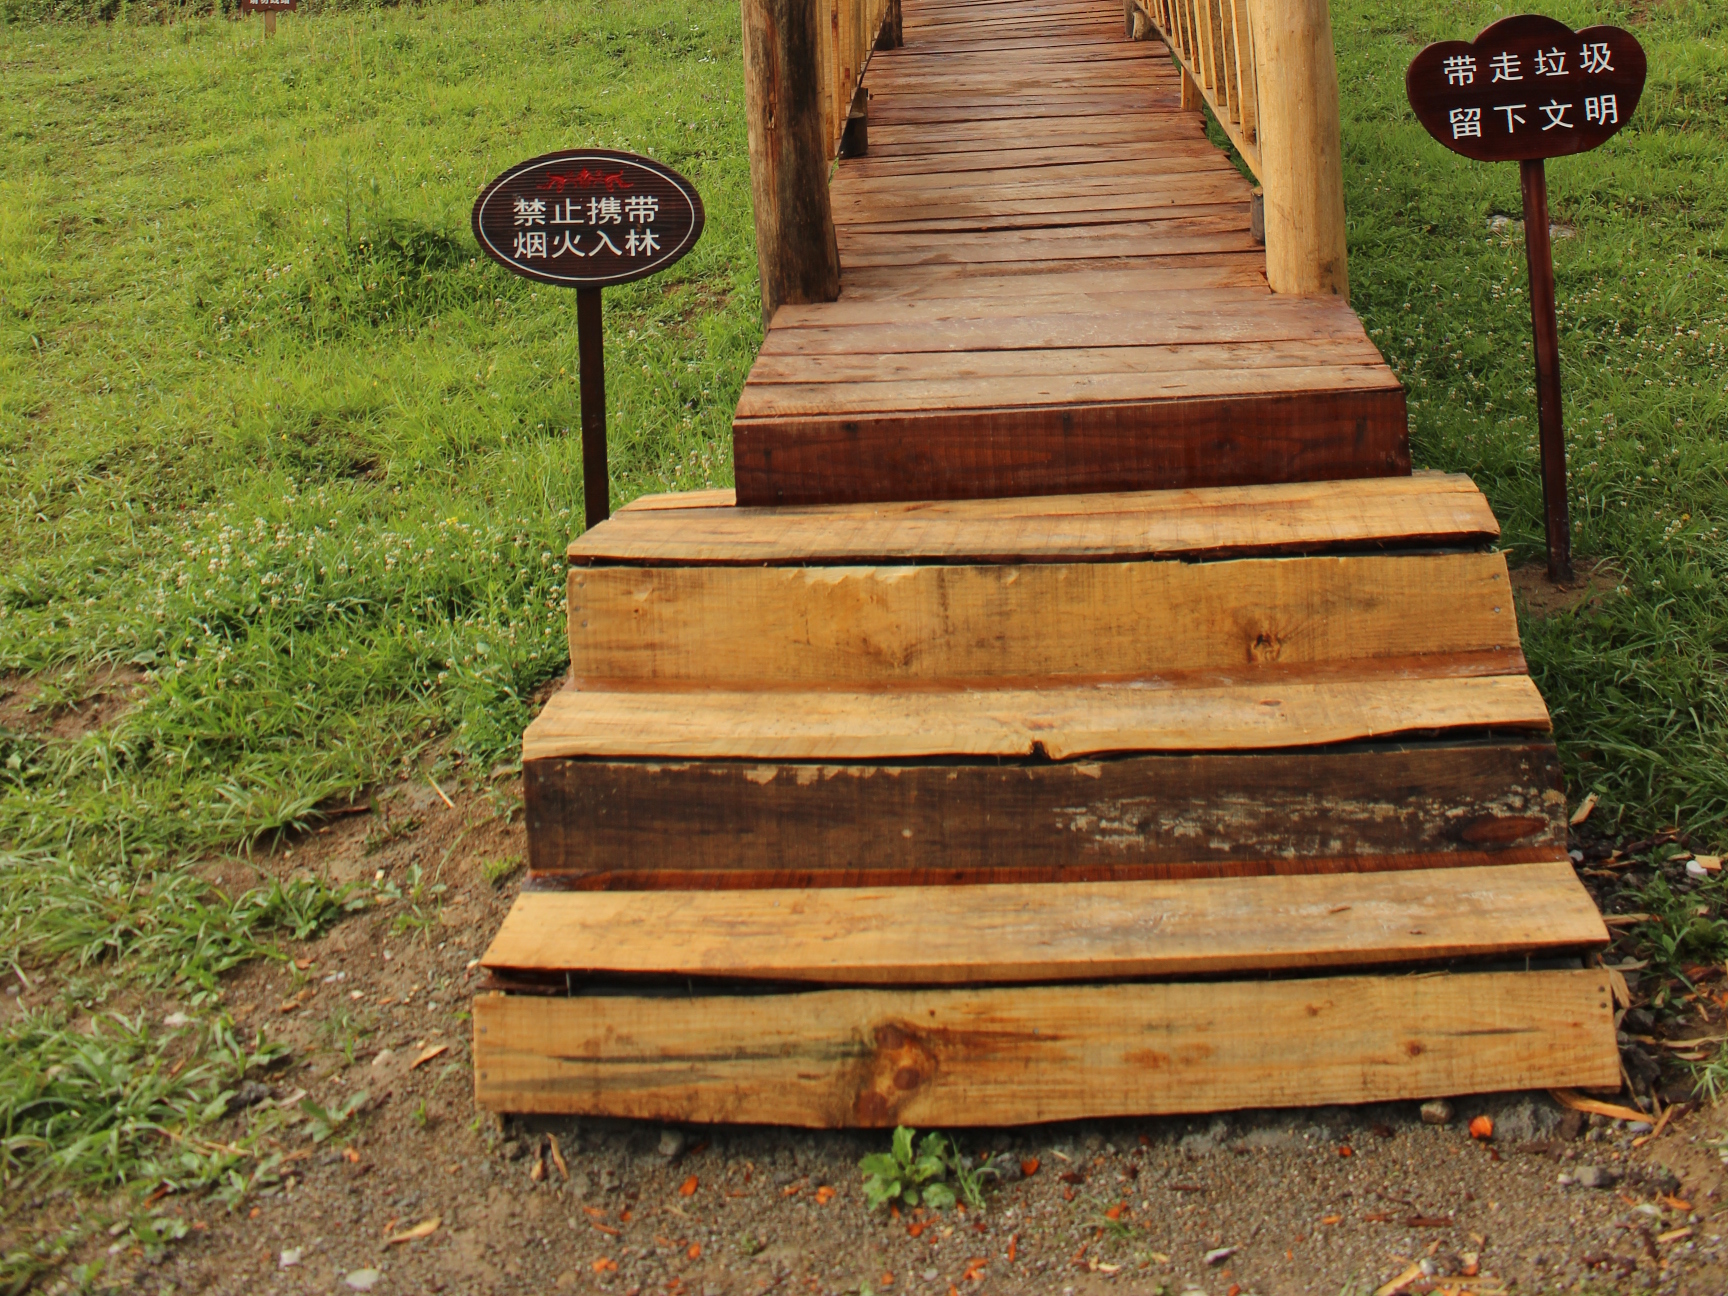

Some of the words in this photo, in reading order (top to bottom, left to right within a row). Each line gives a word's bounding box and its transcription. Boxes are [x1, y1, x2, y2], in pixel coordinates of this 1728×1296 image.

[1443, 42, 1614, 86] 带走垃圾
[1449, 93, 1619, 140] 留下文明
[512, 195, 659, 227] 禁止携带
[513, 228, 661, 259] 烟火入林
